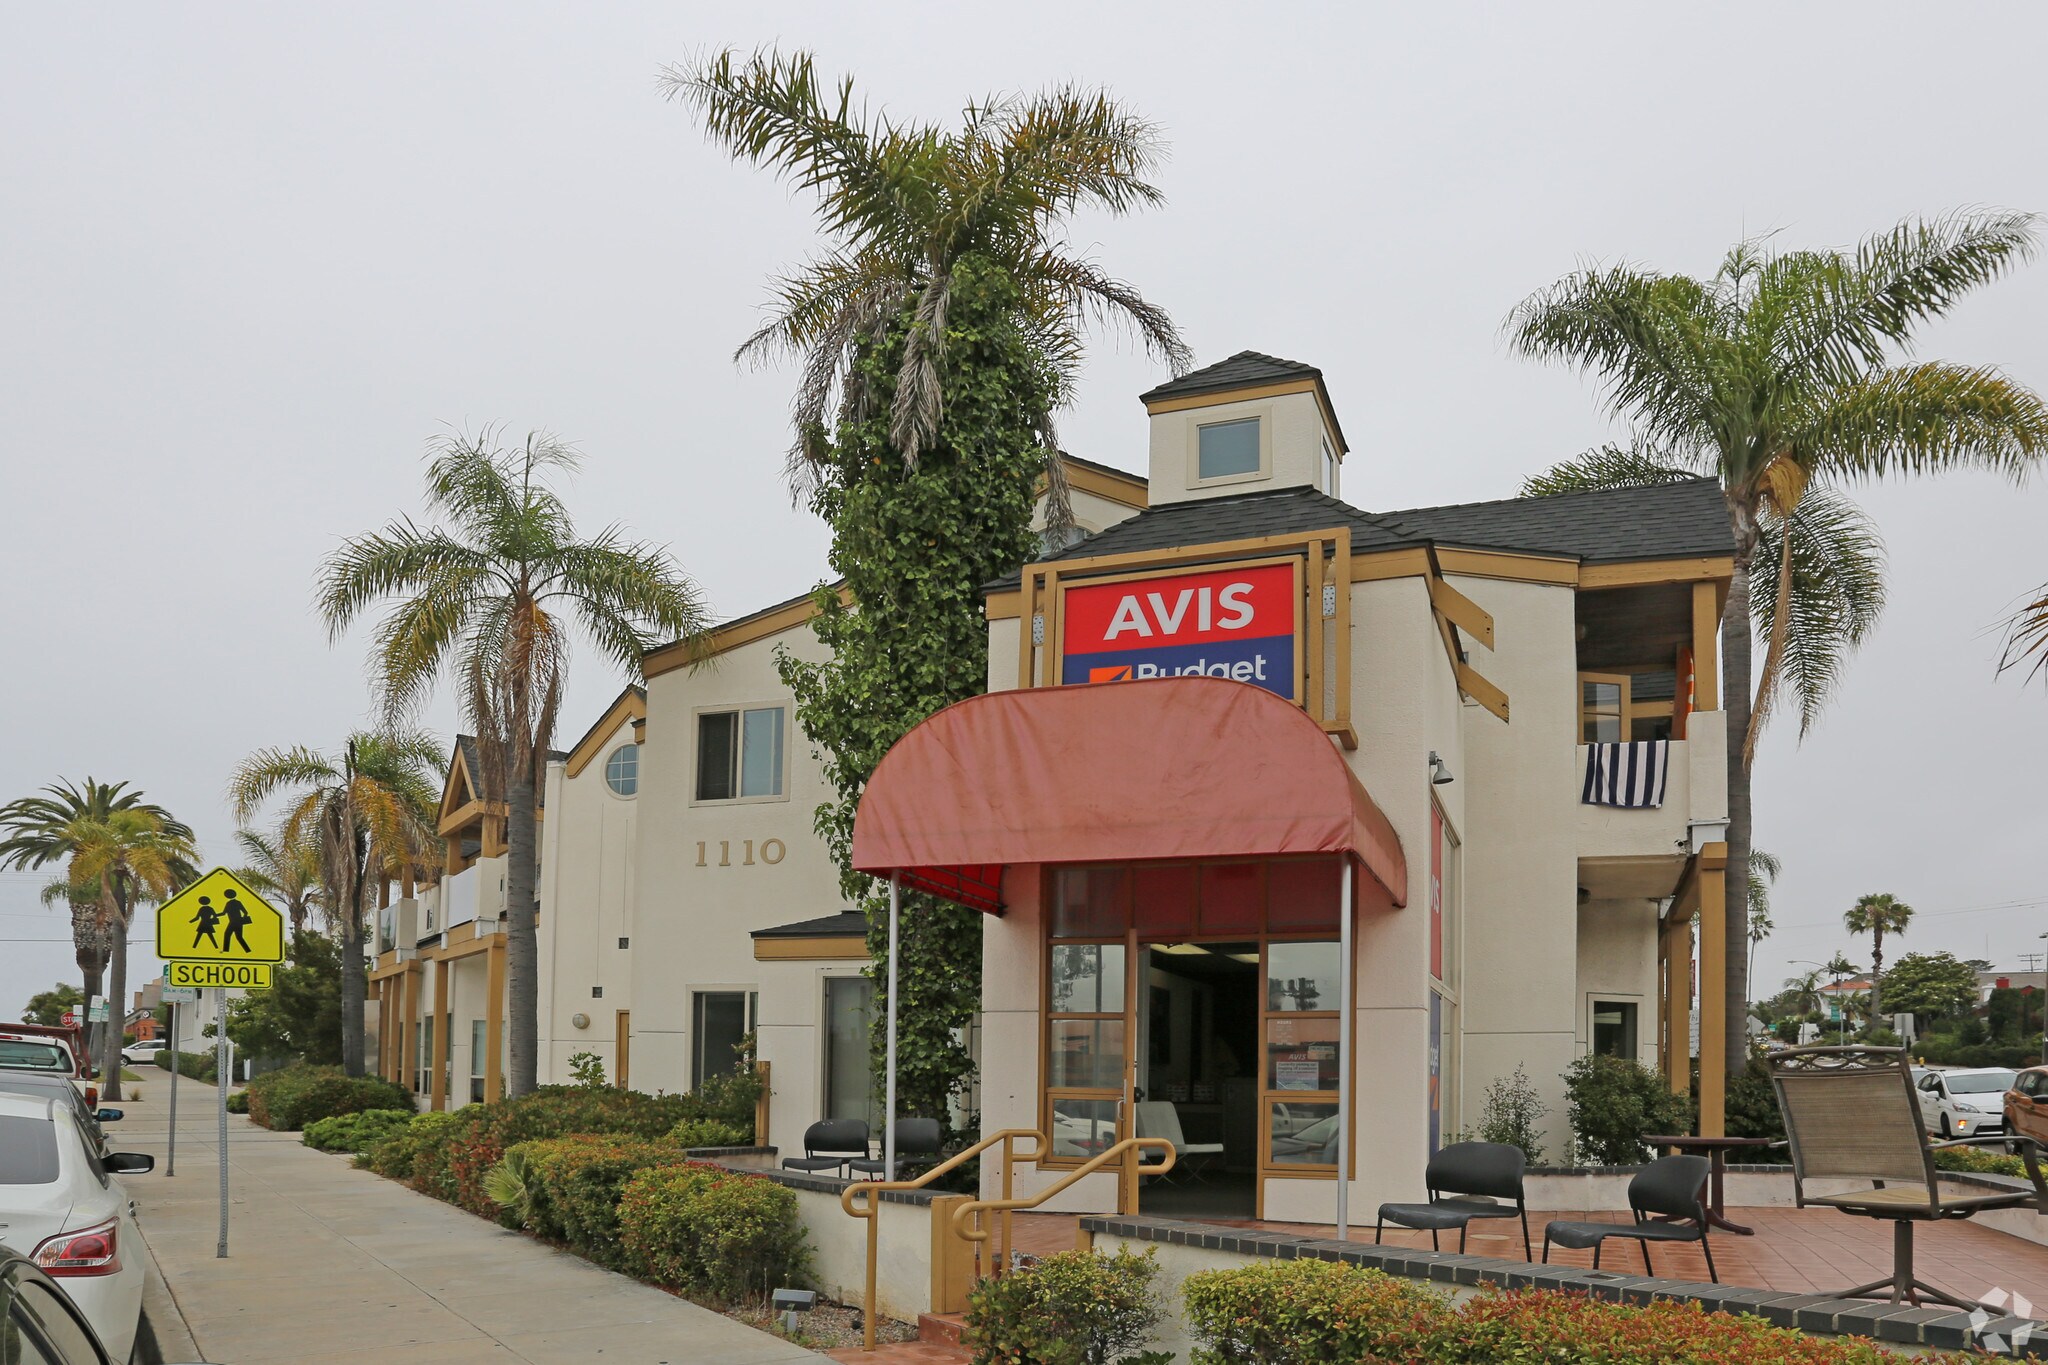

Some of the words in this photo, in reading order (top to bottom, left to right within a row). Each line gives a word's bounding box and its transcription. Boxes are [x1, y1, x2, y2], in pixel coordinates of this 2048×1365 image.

[1103, 582, 1254, 641] AVIS
[695, 838, 786, 867] 1110
[177, 965, 265, 985] SCHOOL
